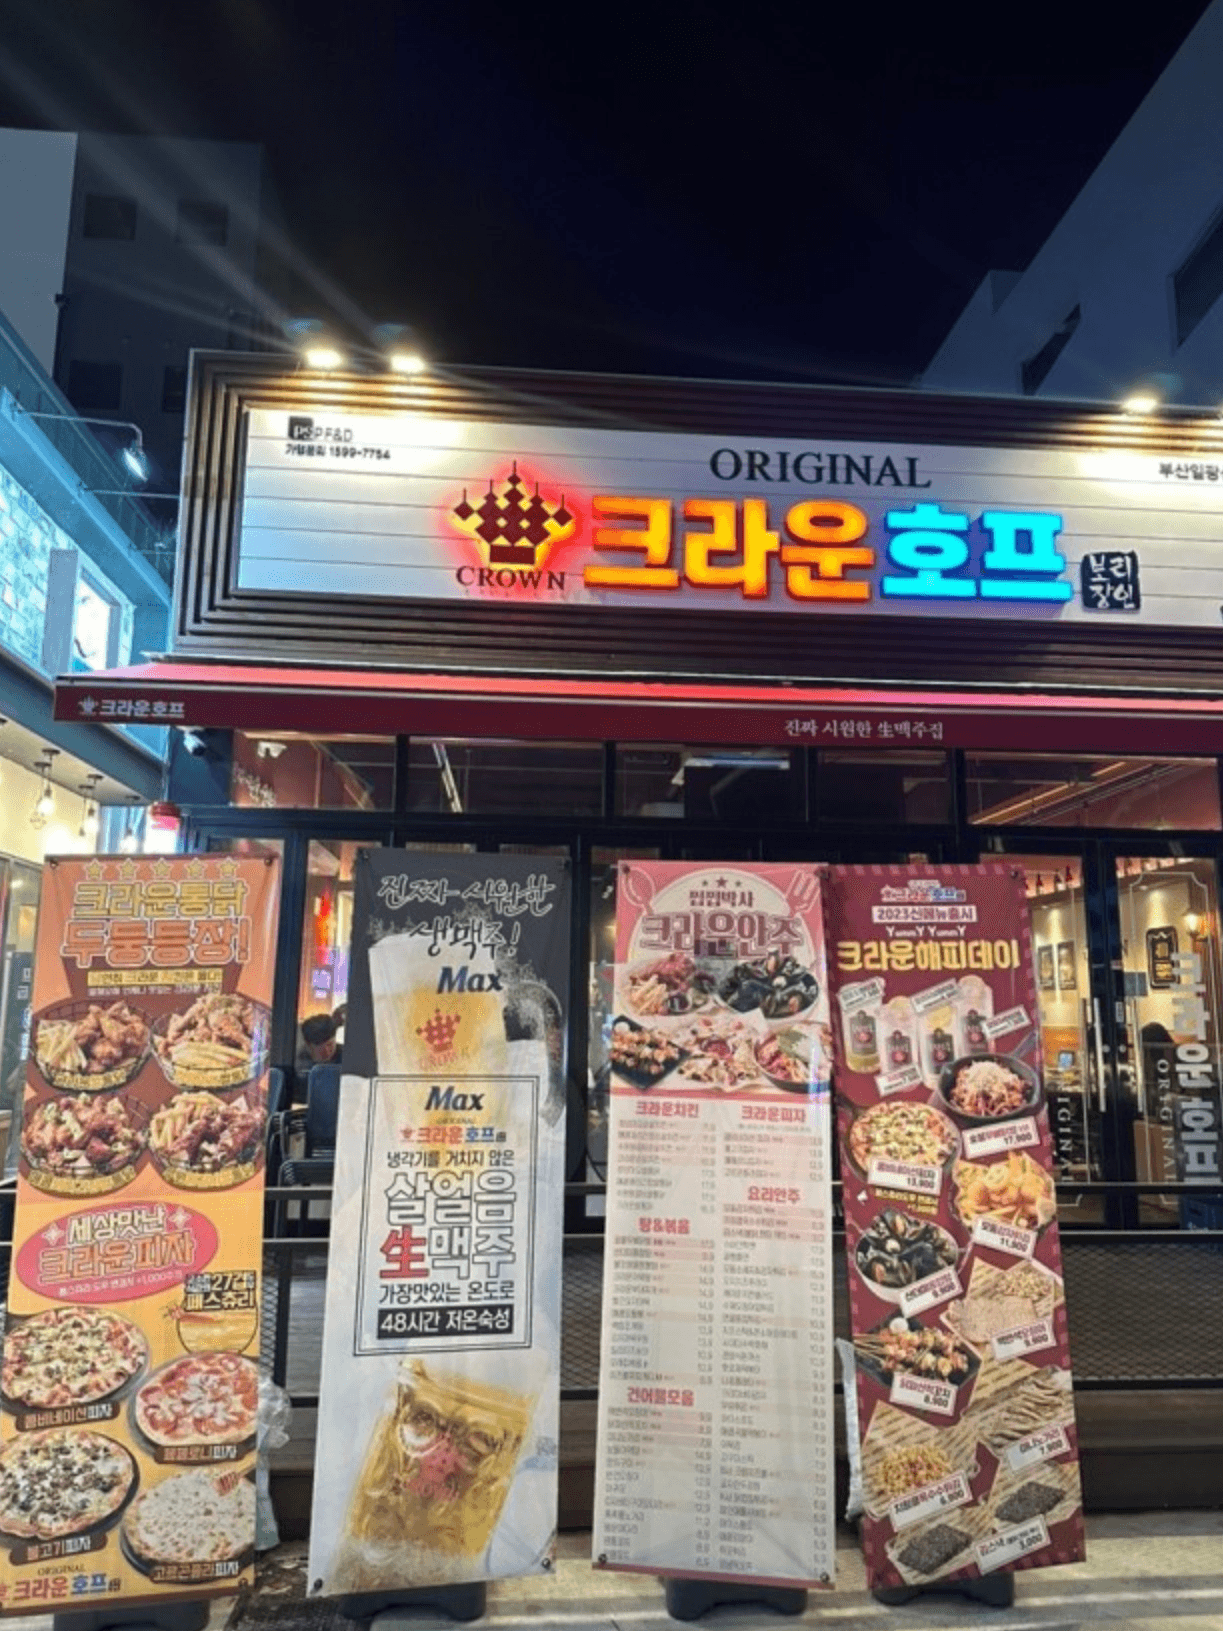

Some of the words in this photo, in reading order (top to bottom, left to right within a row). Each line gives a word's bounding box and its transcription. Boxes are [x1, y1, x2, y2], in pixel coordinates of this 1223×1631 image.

[709, 448, 932, 488] ORIGINAL
[1158, 463, 1223, 481] 부산일광
[583, 495, 1072, 602] 크라운호프
[455, 565, 566, 590] CROWN
[99, 698, 186, 719] 크라운호프
[72, 880, 249, 919] 크라운통닭
[409, 915, 521, 961] 생맥주!
[436, 966, 503, 994] Max
[425, 1086, 485, 1111] Max
[387, 1151, 441, 1169] 냉각기를
[445, 1151, 485, 1167] 거치지
[489, 1150, 515, 1167] 않은
[384, 1169, 518, 1227] 살얼음
[378, 1223, 518, 1281] 生맥주
[378, 1282, 462, 1305] 가장맛있는
[467, 1280, 515, 1301] 온도로
[380, 1311, 441, 1333] 48시간
[445, 1307, 511, 1332] 저온숙성
